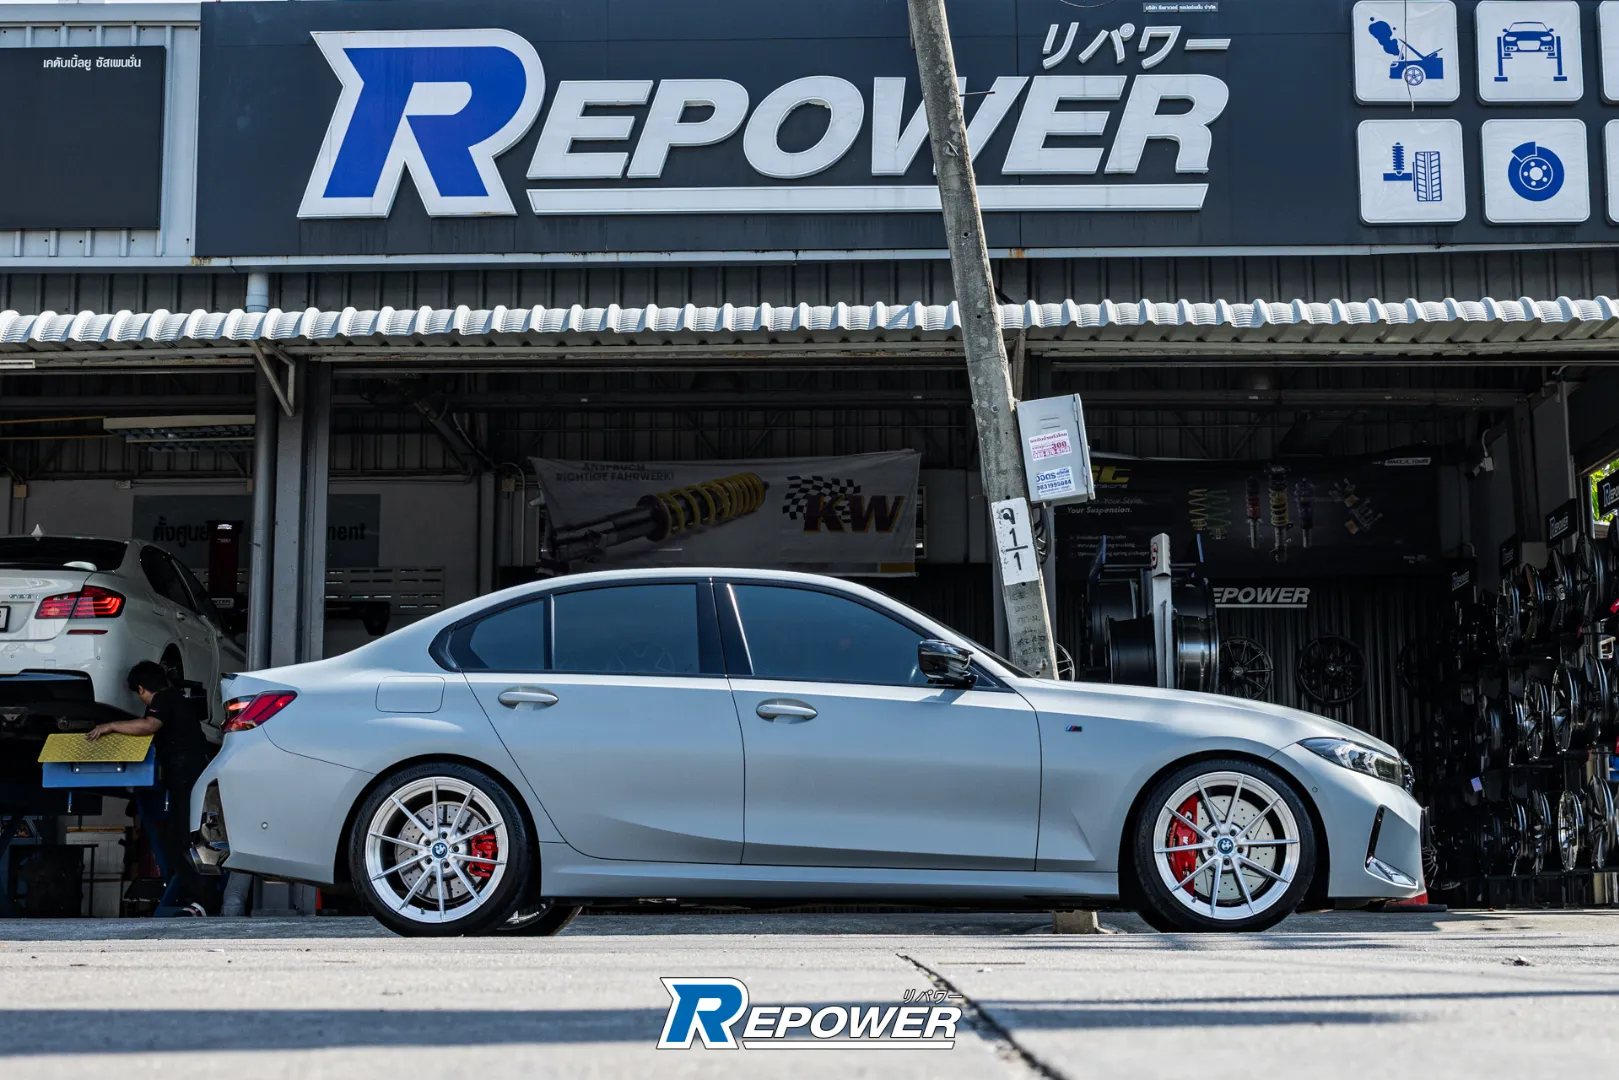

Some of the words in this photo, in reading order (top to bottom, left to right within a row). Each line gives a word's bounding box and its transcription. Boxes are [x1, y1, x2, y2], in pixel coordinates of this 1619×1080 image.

[1042, 22, 1231, 70] リパワー
[43, 54, 92, 71] เคดับเบิ้ลยู
[96, 54, 141, 68] ซัสเพนชั่น
[298, 28, 1229, 218] REPOWER
[556, 472, 608, 481] RICHTIGE
[803, 494, 905, 534] KW
[1067, 506, 1084, 514] Your
[1009, 528, 1018, 546] 1
[1013, 551, 1022, 571] 1
